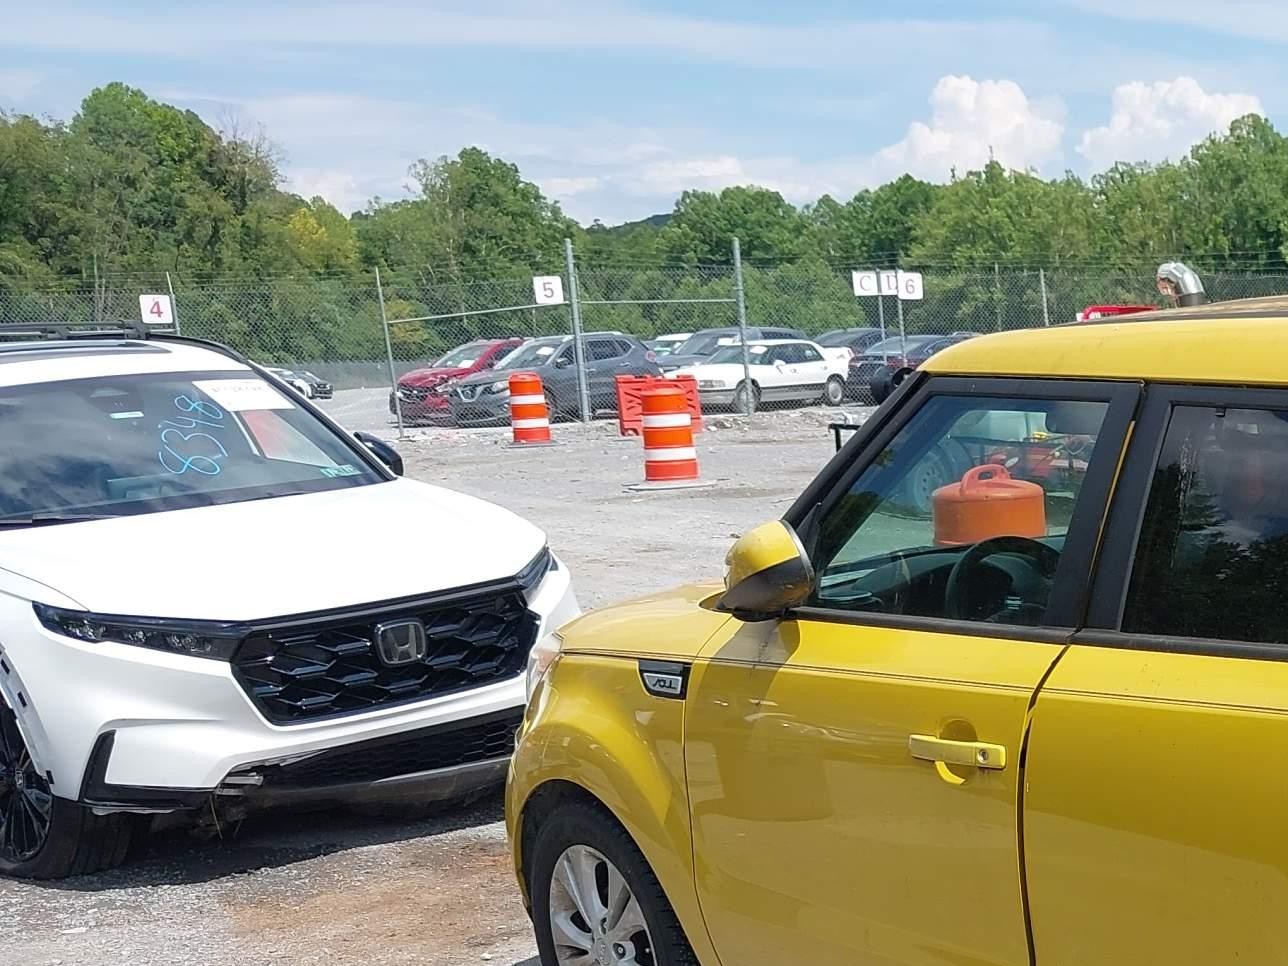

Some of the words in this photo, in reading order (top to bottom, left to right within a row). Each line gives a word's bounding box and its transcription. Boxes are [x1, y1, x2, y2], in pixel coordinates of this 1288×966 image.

[542, 281, 555, 298] 5
[859, 275, 872, 291] C
[905, 279, 916, 294] 6
[149, 300, 164, 318] 4
[157, 395, 229, 475] 8348
